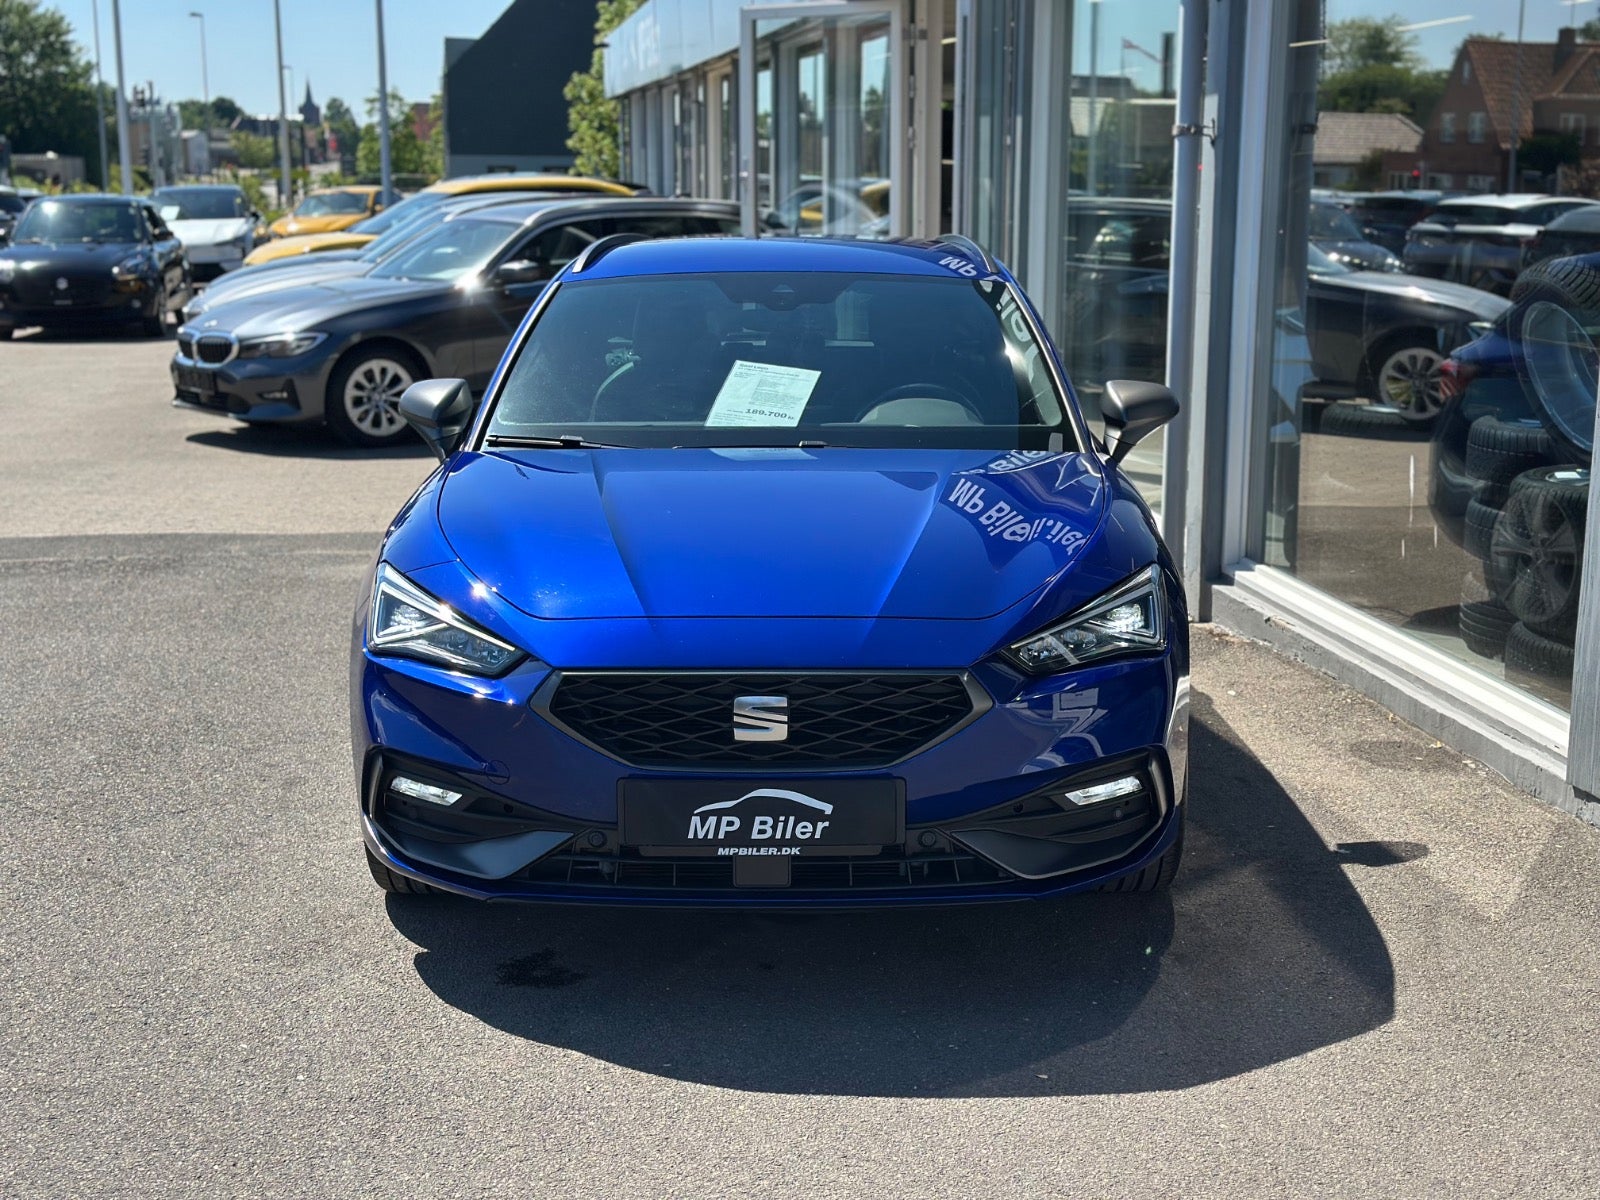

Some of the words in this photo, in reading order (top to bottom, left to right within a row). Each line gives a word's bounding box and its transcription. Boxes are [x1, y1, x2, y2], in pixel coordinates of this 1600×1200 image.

[745, 408, 787, 418] 189.700
[687, 816, 740, 839] MP
[751, 816, 830, 839] Biler
[717, 847, 801, 855] MPBILER.DK
